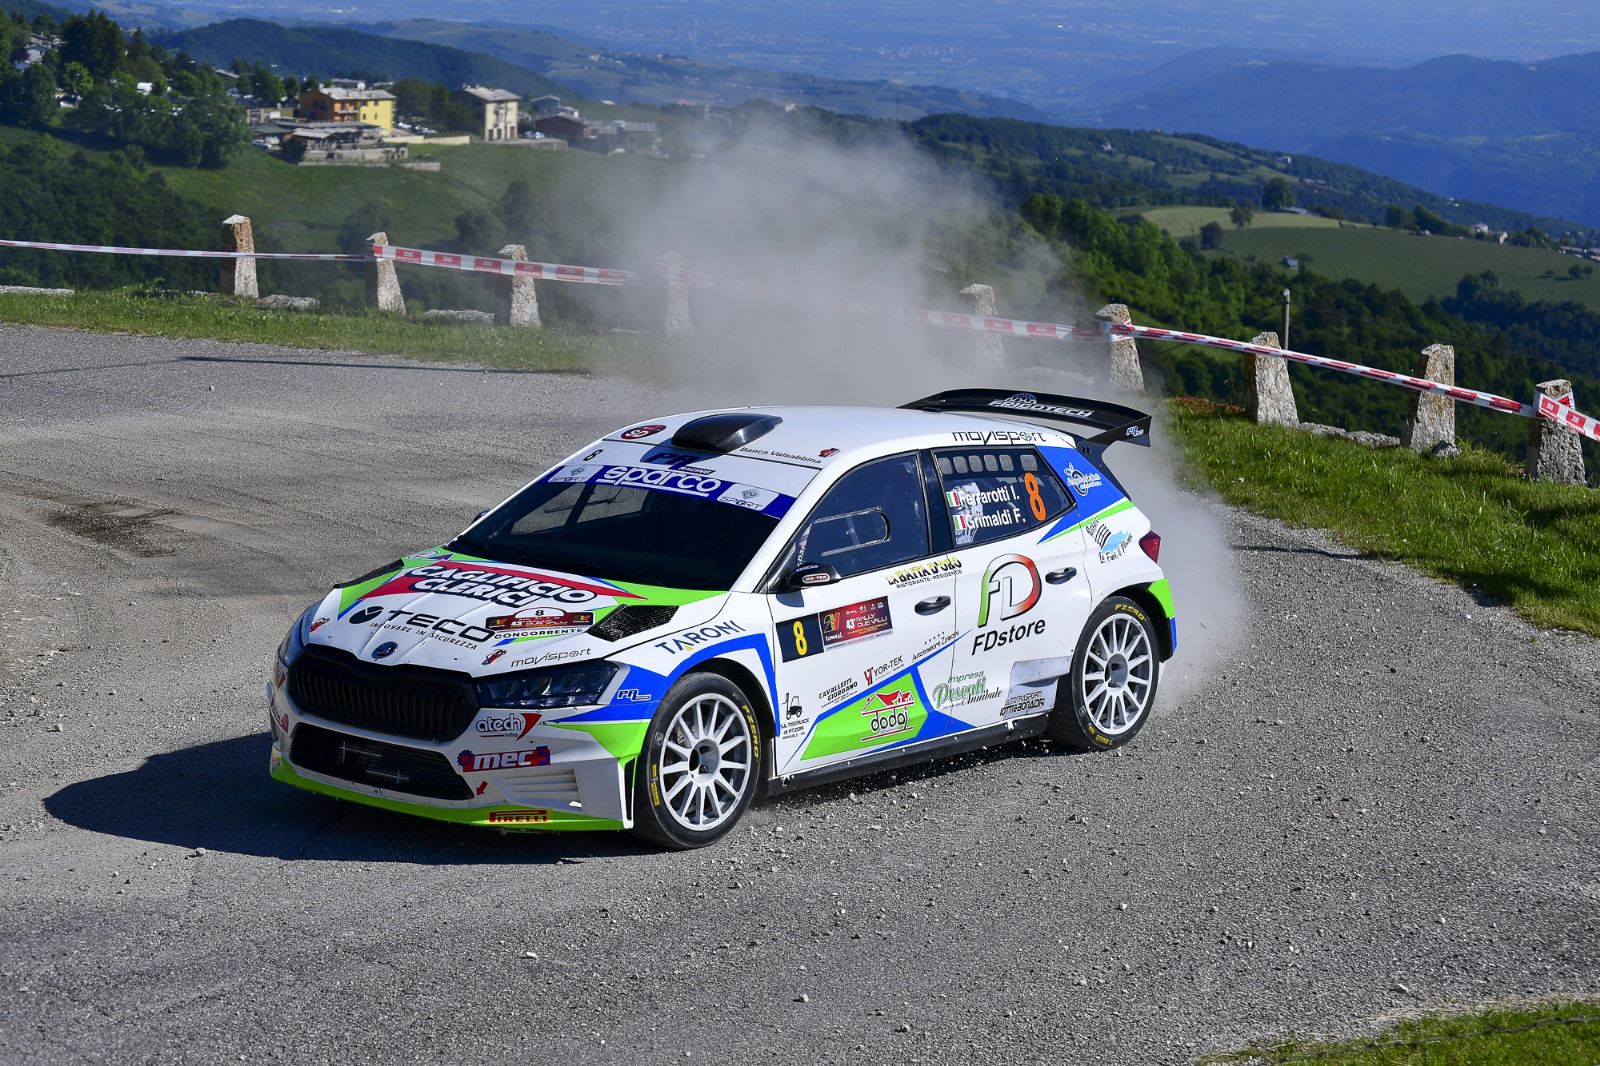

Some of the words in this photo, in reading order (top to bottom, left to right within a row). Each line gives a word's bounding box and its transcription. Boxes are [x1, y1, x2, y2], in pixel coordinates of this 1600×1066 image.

[987, 399, 1094, 418] FRIGOTECH
[952, 430, 1046, 445] movisport
[583, 449, 604, 461] 8
[740, 447, 769, 456] Banca
[771, 450, 822, 464] Valsabbina
[603, 466, 722, 492] sparco
[719, 496, 764, 510] SPORT
[959, 485, 1010, 506] Ferrarotti
[1024, 472, 1047, 521] 8
[965, 509, 1013, 530] Grimaldi
[1013, 508, 1027, 523] F.
[409, 565, 598, 603] CAGLIFICIO
[413, 578, 537, 607] CLERICI
[387, 609, 496, 643] TECO
[494, 628, 583, 639] CONCORRENTE
[429, 632, 478, 651] SICUREZZA
[654, 620, 746, 655] TARONI
[793, 620, 808, 656] 8
[971, 619, 1046, 656] FDstore
[510, 648, 592, 667] movisport
[873, 655, 903, 677] YOR-TEK
[948, 671, 985, 684] Impresa
[827, 681, 858, 701] GIORDANO
[476, 713, 521, 732] atech
[489, 809, 548, 823] PIRELLI
